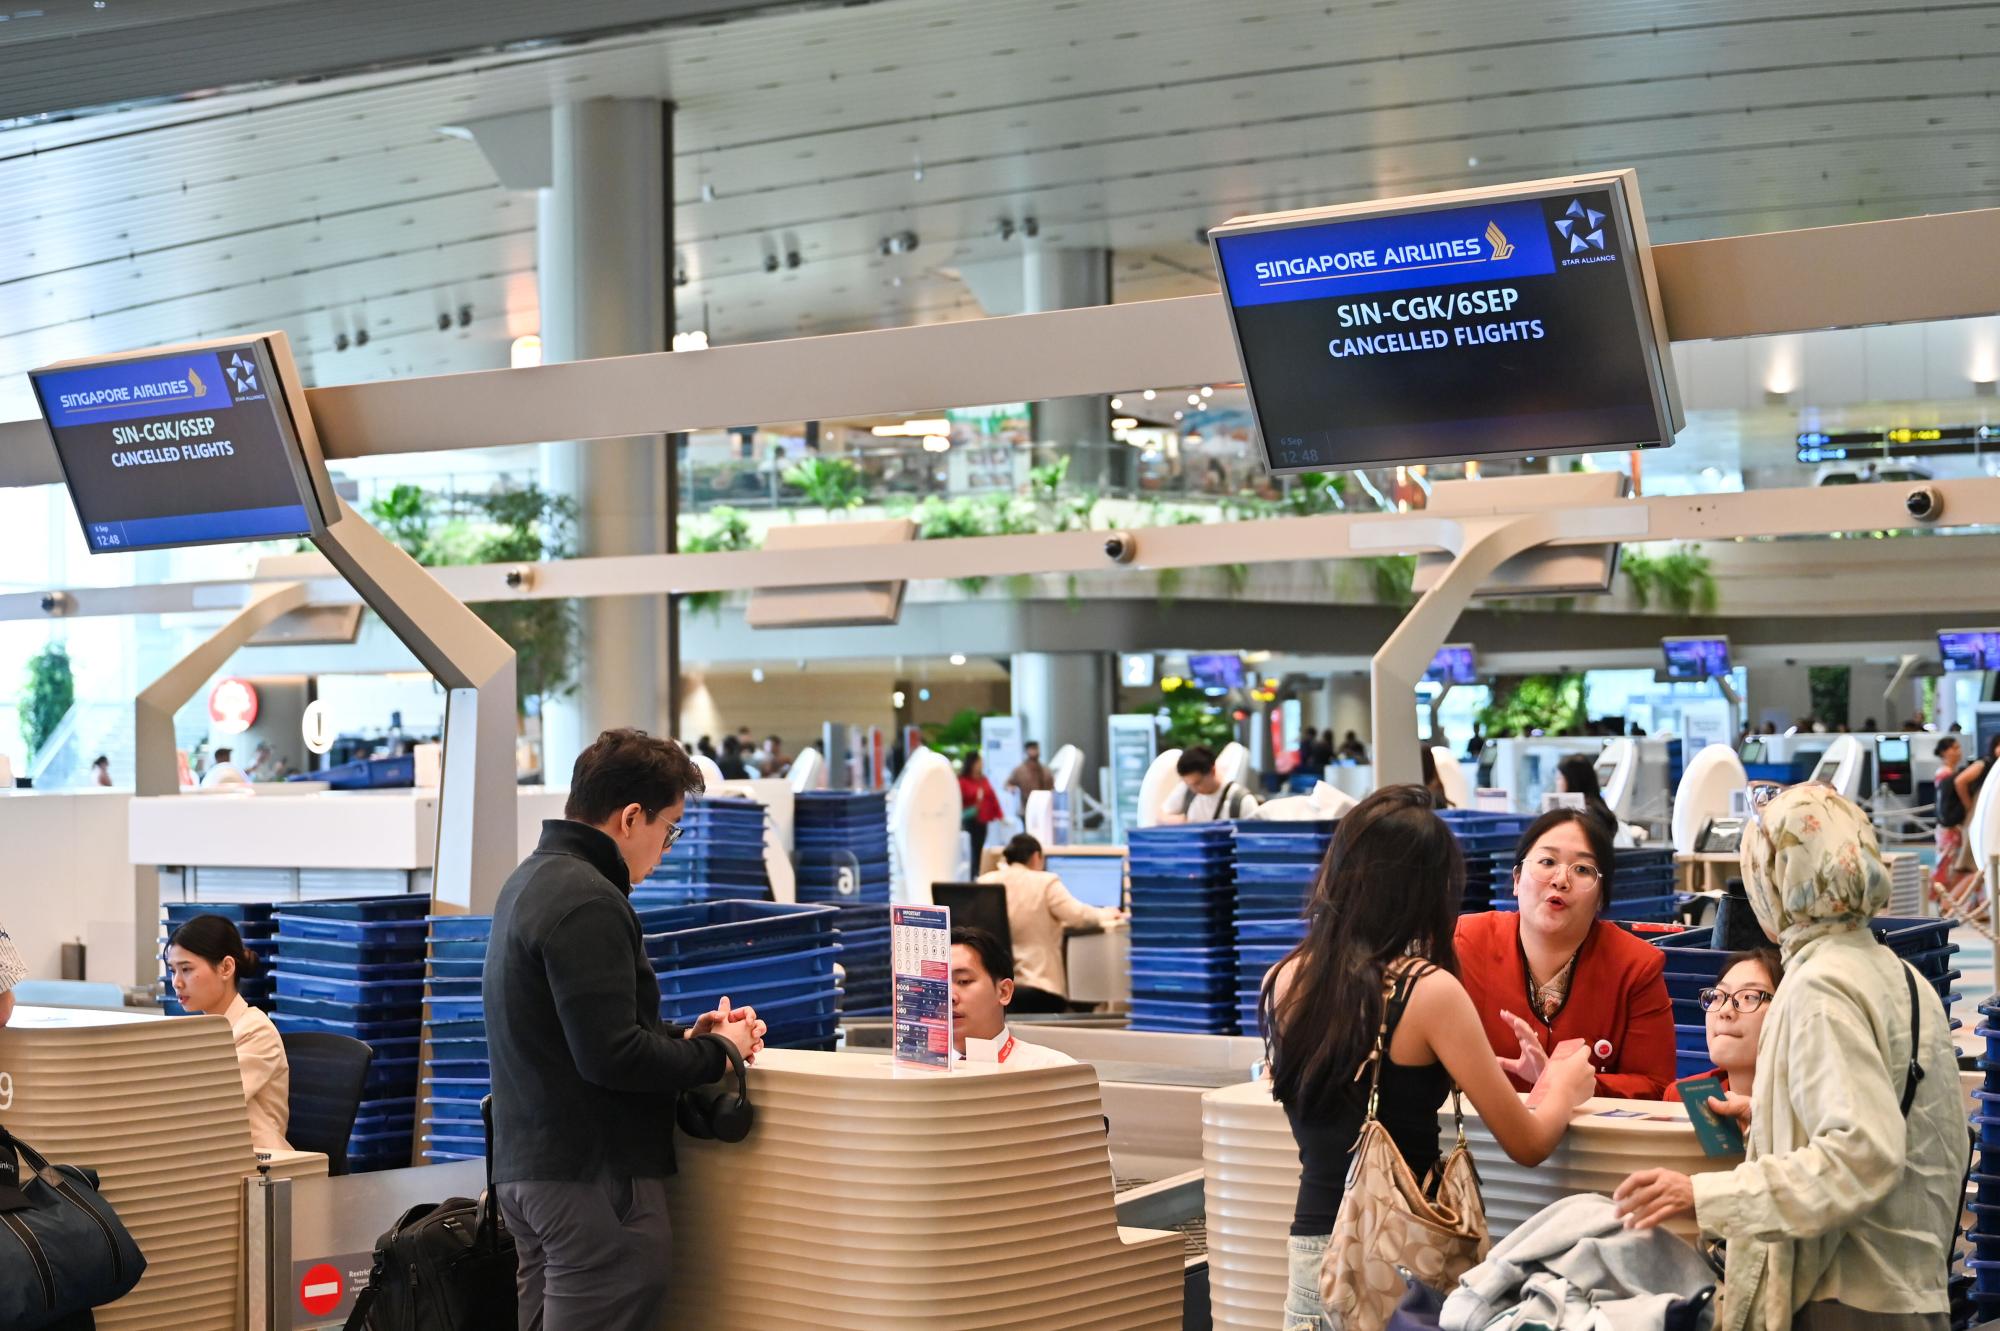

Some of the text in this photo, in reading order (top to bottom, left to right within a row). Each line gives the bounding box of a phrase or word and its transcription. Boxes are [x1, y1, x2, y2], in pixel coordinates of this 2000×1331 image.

[1255, 238, 1481, 279] SINGAPORE AIRLINES
[1562, 254, 1616, 266] STAR ALLIANCE
[1337, 287, 1519, 328] SIN-CGK/6SEP
[1329, 319, 1545, 358] CANCELLED FLIGHTS
[60, 379, 188, 408] SINGAPORE AIRLINES
[112, 416, 215, 445] SIN-CGK/6SEP
[111, 440, 234, 468] CANCELLED FLIGHTS
[97, 534, 120, 546] 12:48
[1129, 656, 1146, 684] 2
[0, 1071, 14, 1110] 9
